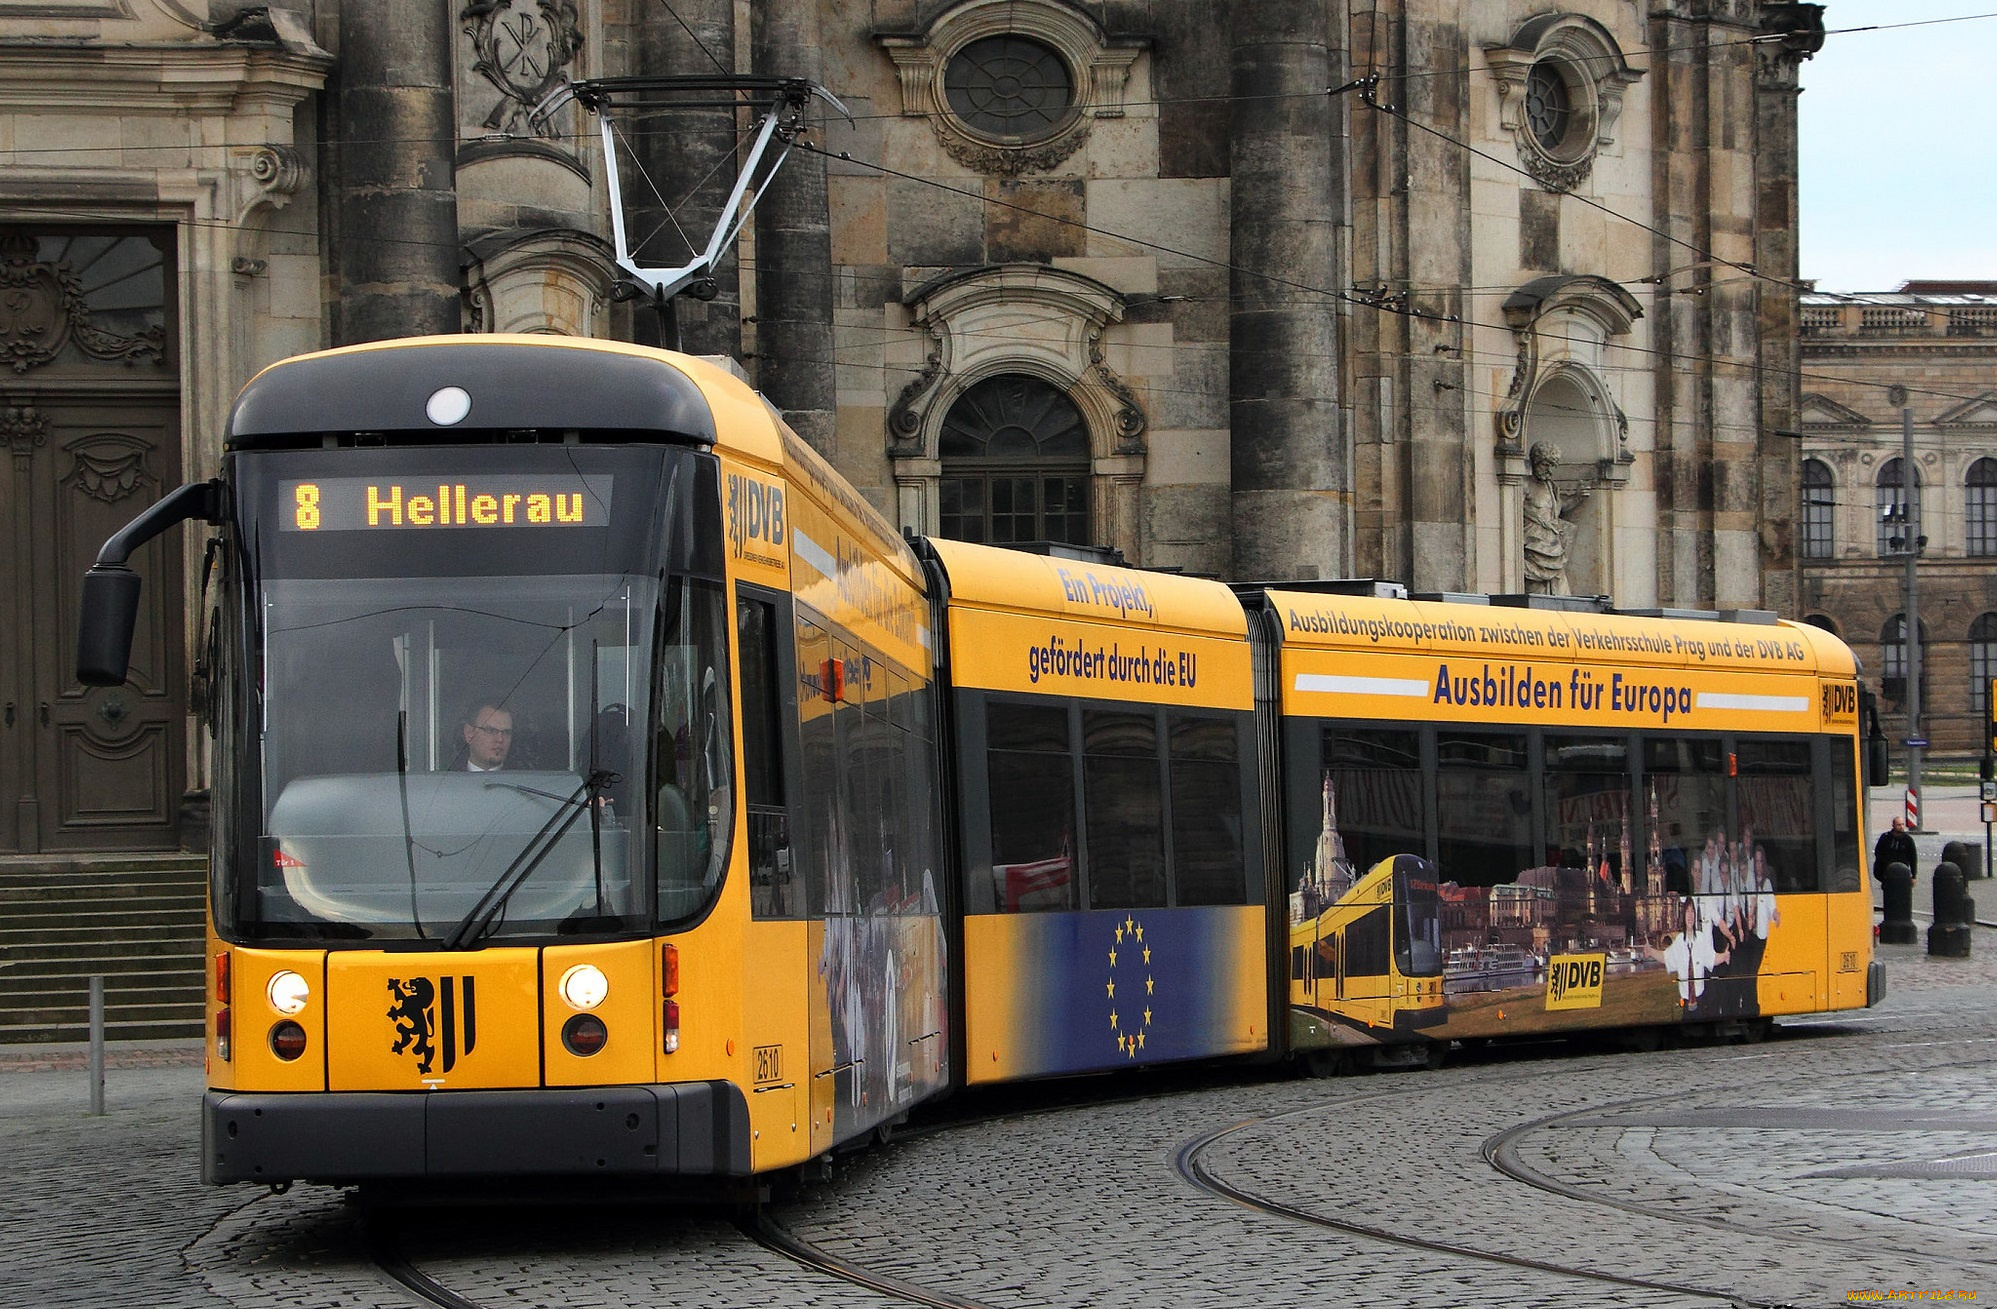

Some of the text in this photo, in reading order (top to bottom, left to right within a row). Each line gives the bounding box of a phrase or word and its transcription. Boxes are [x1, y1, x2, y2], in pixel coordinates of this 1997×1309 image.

[295, 484, 584, 530] 8 Hellerau
[748, 478, 784, 546] DVB
[1057, 568, 1153, 619] Ein Projekt,
[1289, 608, 1805, 662] Ausbildungskooperation zwischen der Verkehrsschule Prag und der DVB AG
[1029, 635, 1197, 689] gefördert durch die EU
[1433, 664, 1692, 724] Ausbilden für Europa
[1834, 685, 1855, 714] DVB
[1568, 961, 1601, 989] DVB
[757, 1047, 779, 1080] 2610
